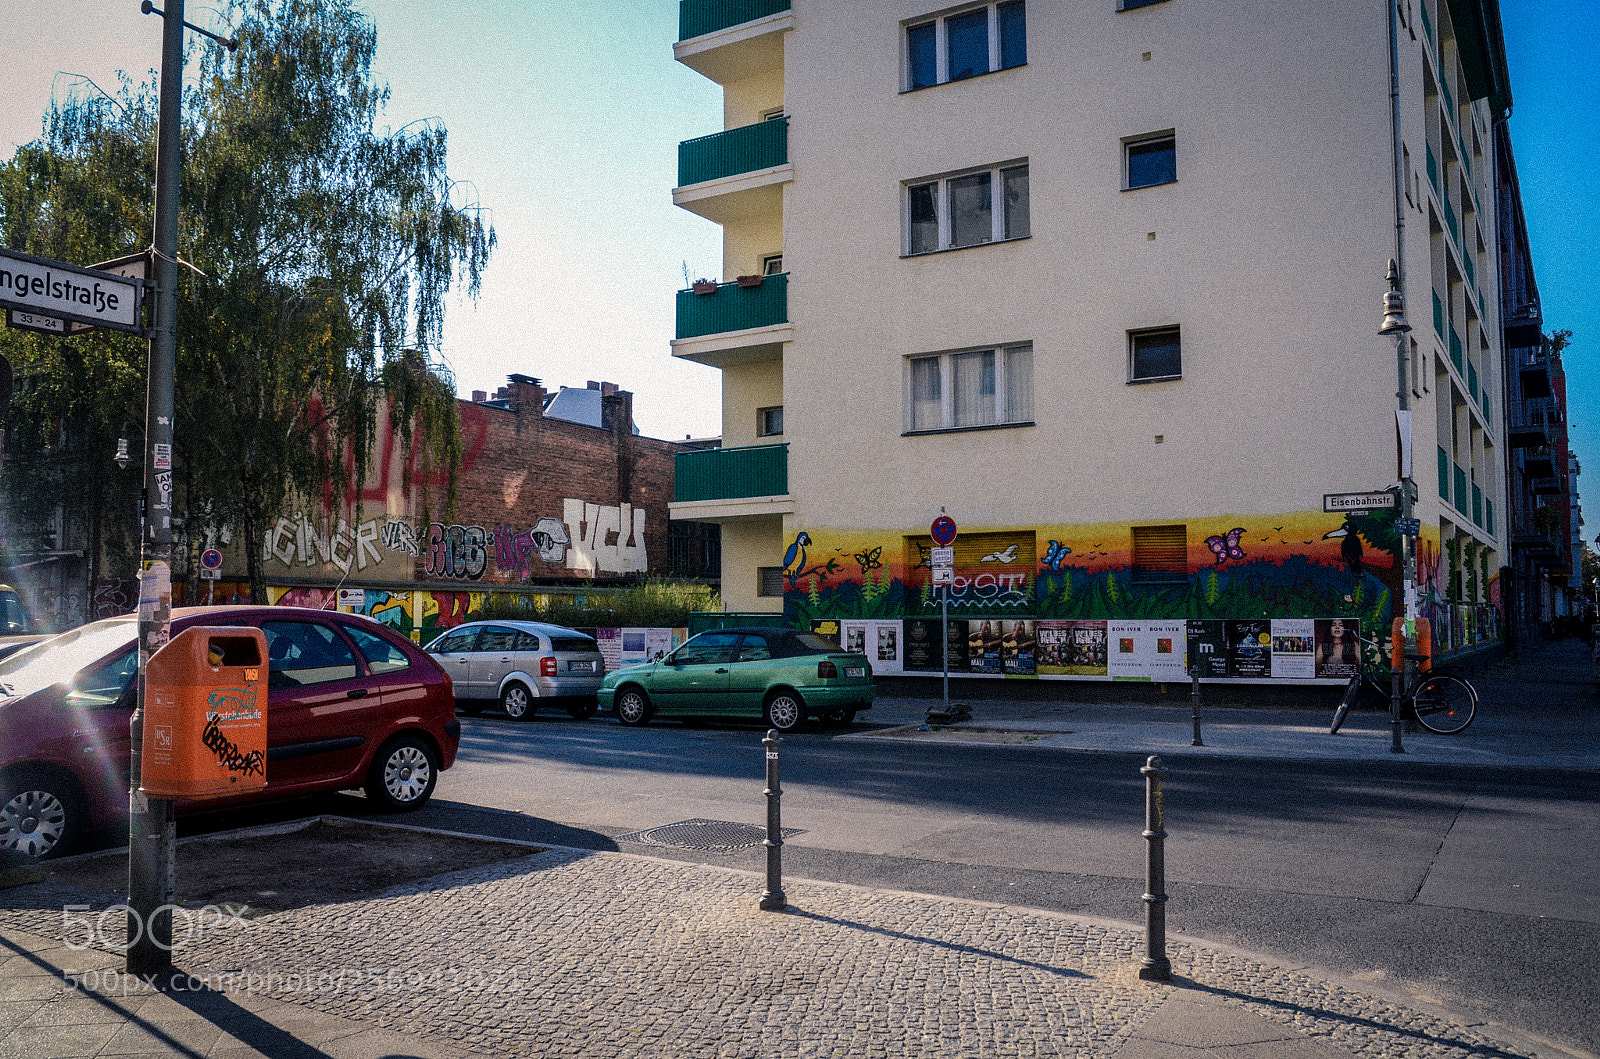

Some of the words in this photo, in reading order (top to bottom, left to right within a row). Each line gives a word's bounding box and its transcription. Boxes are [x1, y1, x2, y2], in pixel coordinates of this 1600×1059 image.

[21, 314, 33, 324] 33
[45, 319, 57, 328] 24
[1331, 496, 1392, 507] Eisenbahnstr.
[970, 659, 984, 667] MALI
[1005, 659, 1018, 668] MALI
[156, 730, 170, 746] BSR
